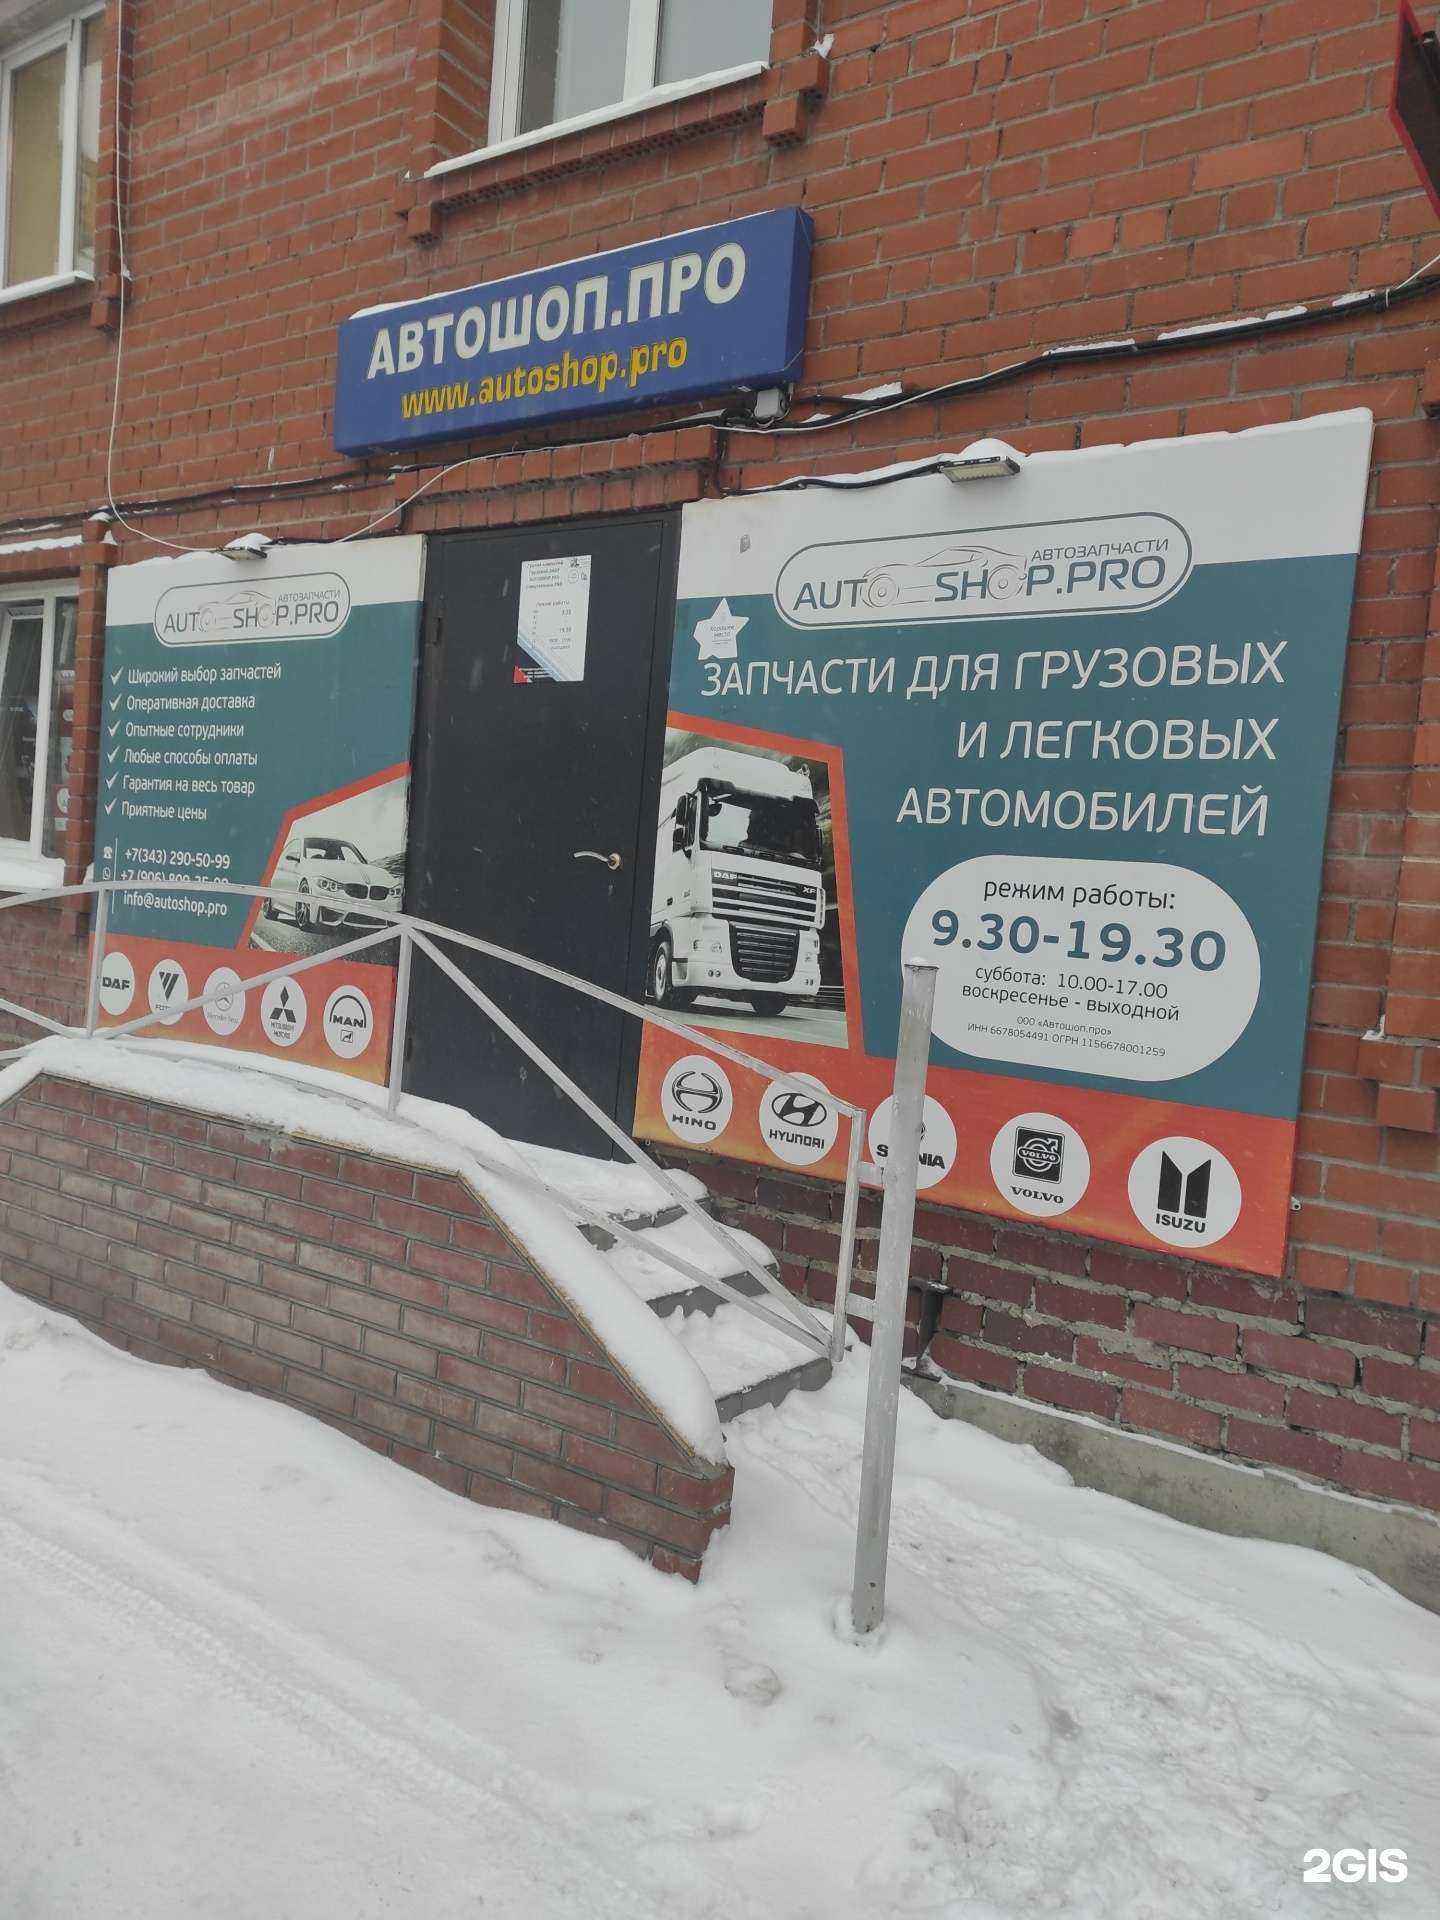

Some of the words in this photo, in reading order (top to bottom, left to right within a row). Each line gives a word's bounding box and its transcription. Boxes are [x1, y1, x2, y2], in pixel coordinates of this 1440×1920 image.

[366, 242, 746, 380] АВТОШОП.ПРО
[401, 337, 687, 418] www.autoshop.pro
[1031, 538, 1168, 562] АВТОЗАПЧАСТИ
[128, 665, 178, 685] Широкий
[181, 664, 217, 685] выбор
[220, 662, 281, 682] запчастей
[701, 657, 896, 696] ЗАПЧАСТИ
[907, 653, 999, 700] ДЛЯ
[1015, 640, 1288, 690] ГРУЗОВЫХ
[127, 695, 198, 714] Оперативная
[201, 695, 256, 711] доставка
[126, 722, 175, 738] Опытные
[178, 722, 244, 740] сотрудники
[957, 720, 988, 759] И
[1000, 718, 1279, 760] ЛЕГКОВЫХ
[124, 748, 161, 765] Любые
[164, 748, 210, 765] способы
[214, 751, 257, 766] оплаты
[123, 775, 172, 793] Гарантия
[175, 777, 189, 791] на
[192, 778, 217, 793] весь
[221, 779, 255, 797] товар
[122, 800, 174, 818] Приятные
[177, 804, 207, 821] цены
[896, 784, 1268, 836] АВТОМОБИЛЕЙ
[125, 847, 167, 865] +7(343)
[170, 851, 230, 869] 290-50-99
[124, 890, 227, 917] info@autoshop.pro
[984, 880, 1064, 902] режим
[1072, 883, 1176, 910] работы:
[931, 909, 1226, 971] 9.30-19.30
[102, 976, 130, 990] DAF
[975, 966, 1046, 986] суббота:
[1058, 973, 1168, 999] 10.00-17.00
[963, 985, 1069, 1009] воскресенье
[1087, 998, 1180, 1022] выходной
[332, 1014, 364, 1029] MAN
[1017, 1016, 1035, 1026] ООО
[968, 1023, 988, 1033] ИНН
[990, 1027, 1049, 1042] 6678054491
[1052, 1034, 1079, 1045] ОГРН
[671, 1113, 717, 1131] HINO
[769, 1128, 825, 1150] HYUNDAI
[876, 1144, 946, 1170] SNIA
[1020, 1148, 1056, 1162] VOLVO
[1009, 1185, 1064, 1205] VOLVO
[1155, 1212, 1207, 1234] ISUZU
